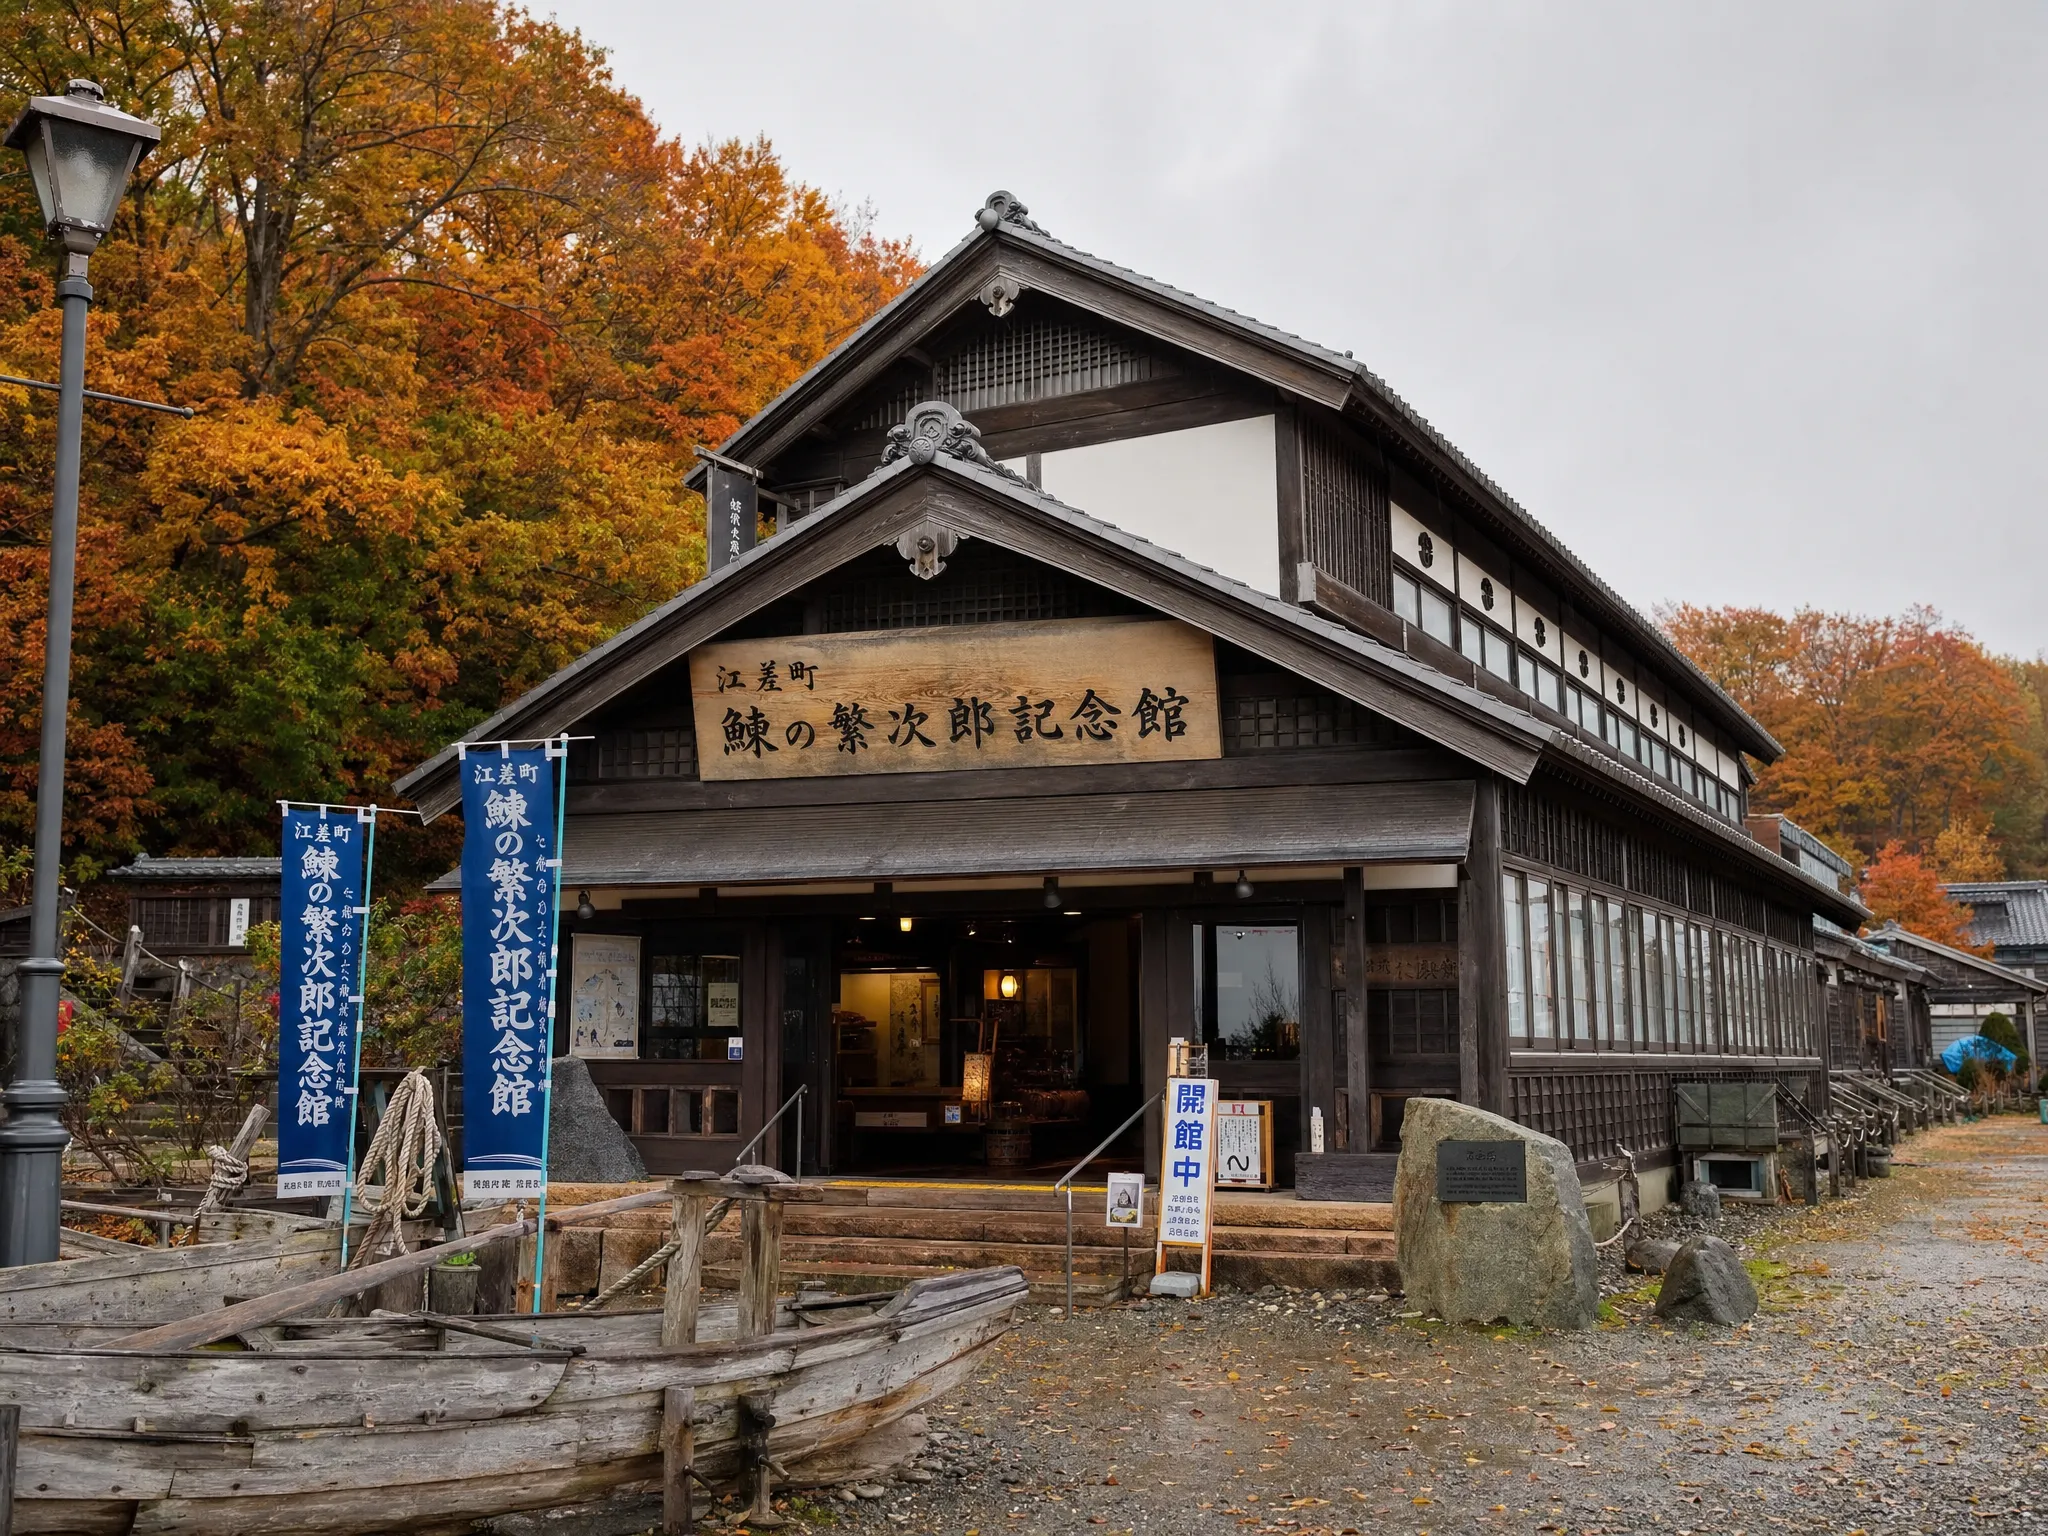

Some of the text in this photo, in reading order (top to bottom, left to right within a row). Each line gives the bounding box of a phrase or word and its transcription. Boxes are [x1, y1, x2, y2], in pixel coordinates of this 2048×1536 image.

[716, 659, 819, 693] 江差町
[721, 686, 1190, 759] 鰊の繁次郎記念館
[474, 762, 539, 785] 江差町
[294, 821, 352, 844] 江差町
[295, 845, 342, 1128] 鰊の繁次郎記念館
[483, 788, 536, 1118] 鰊の繁次郎記念館
[1173, 1084, 1206, 1187] 開館中
